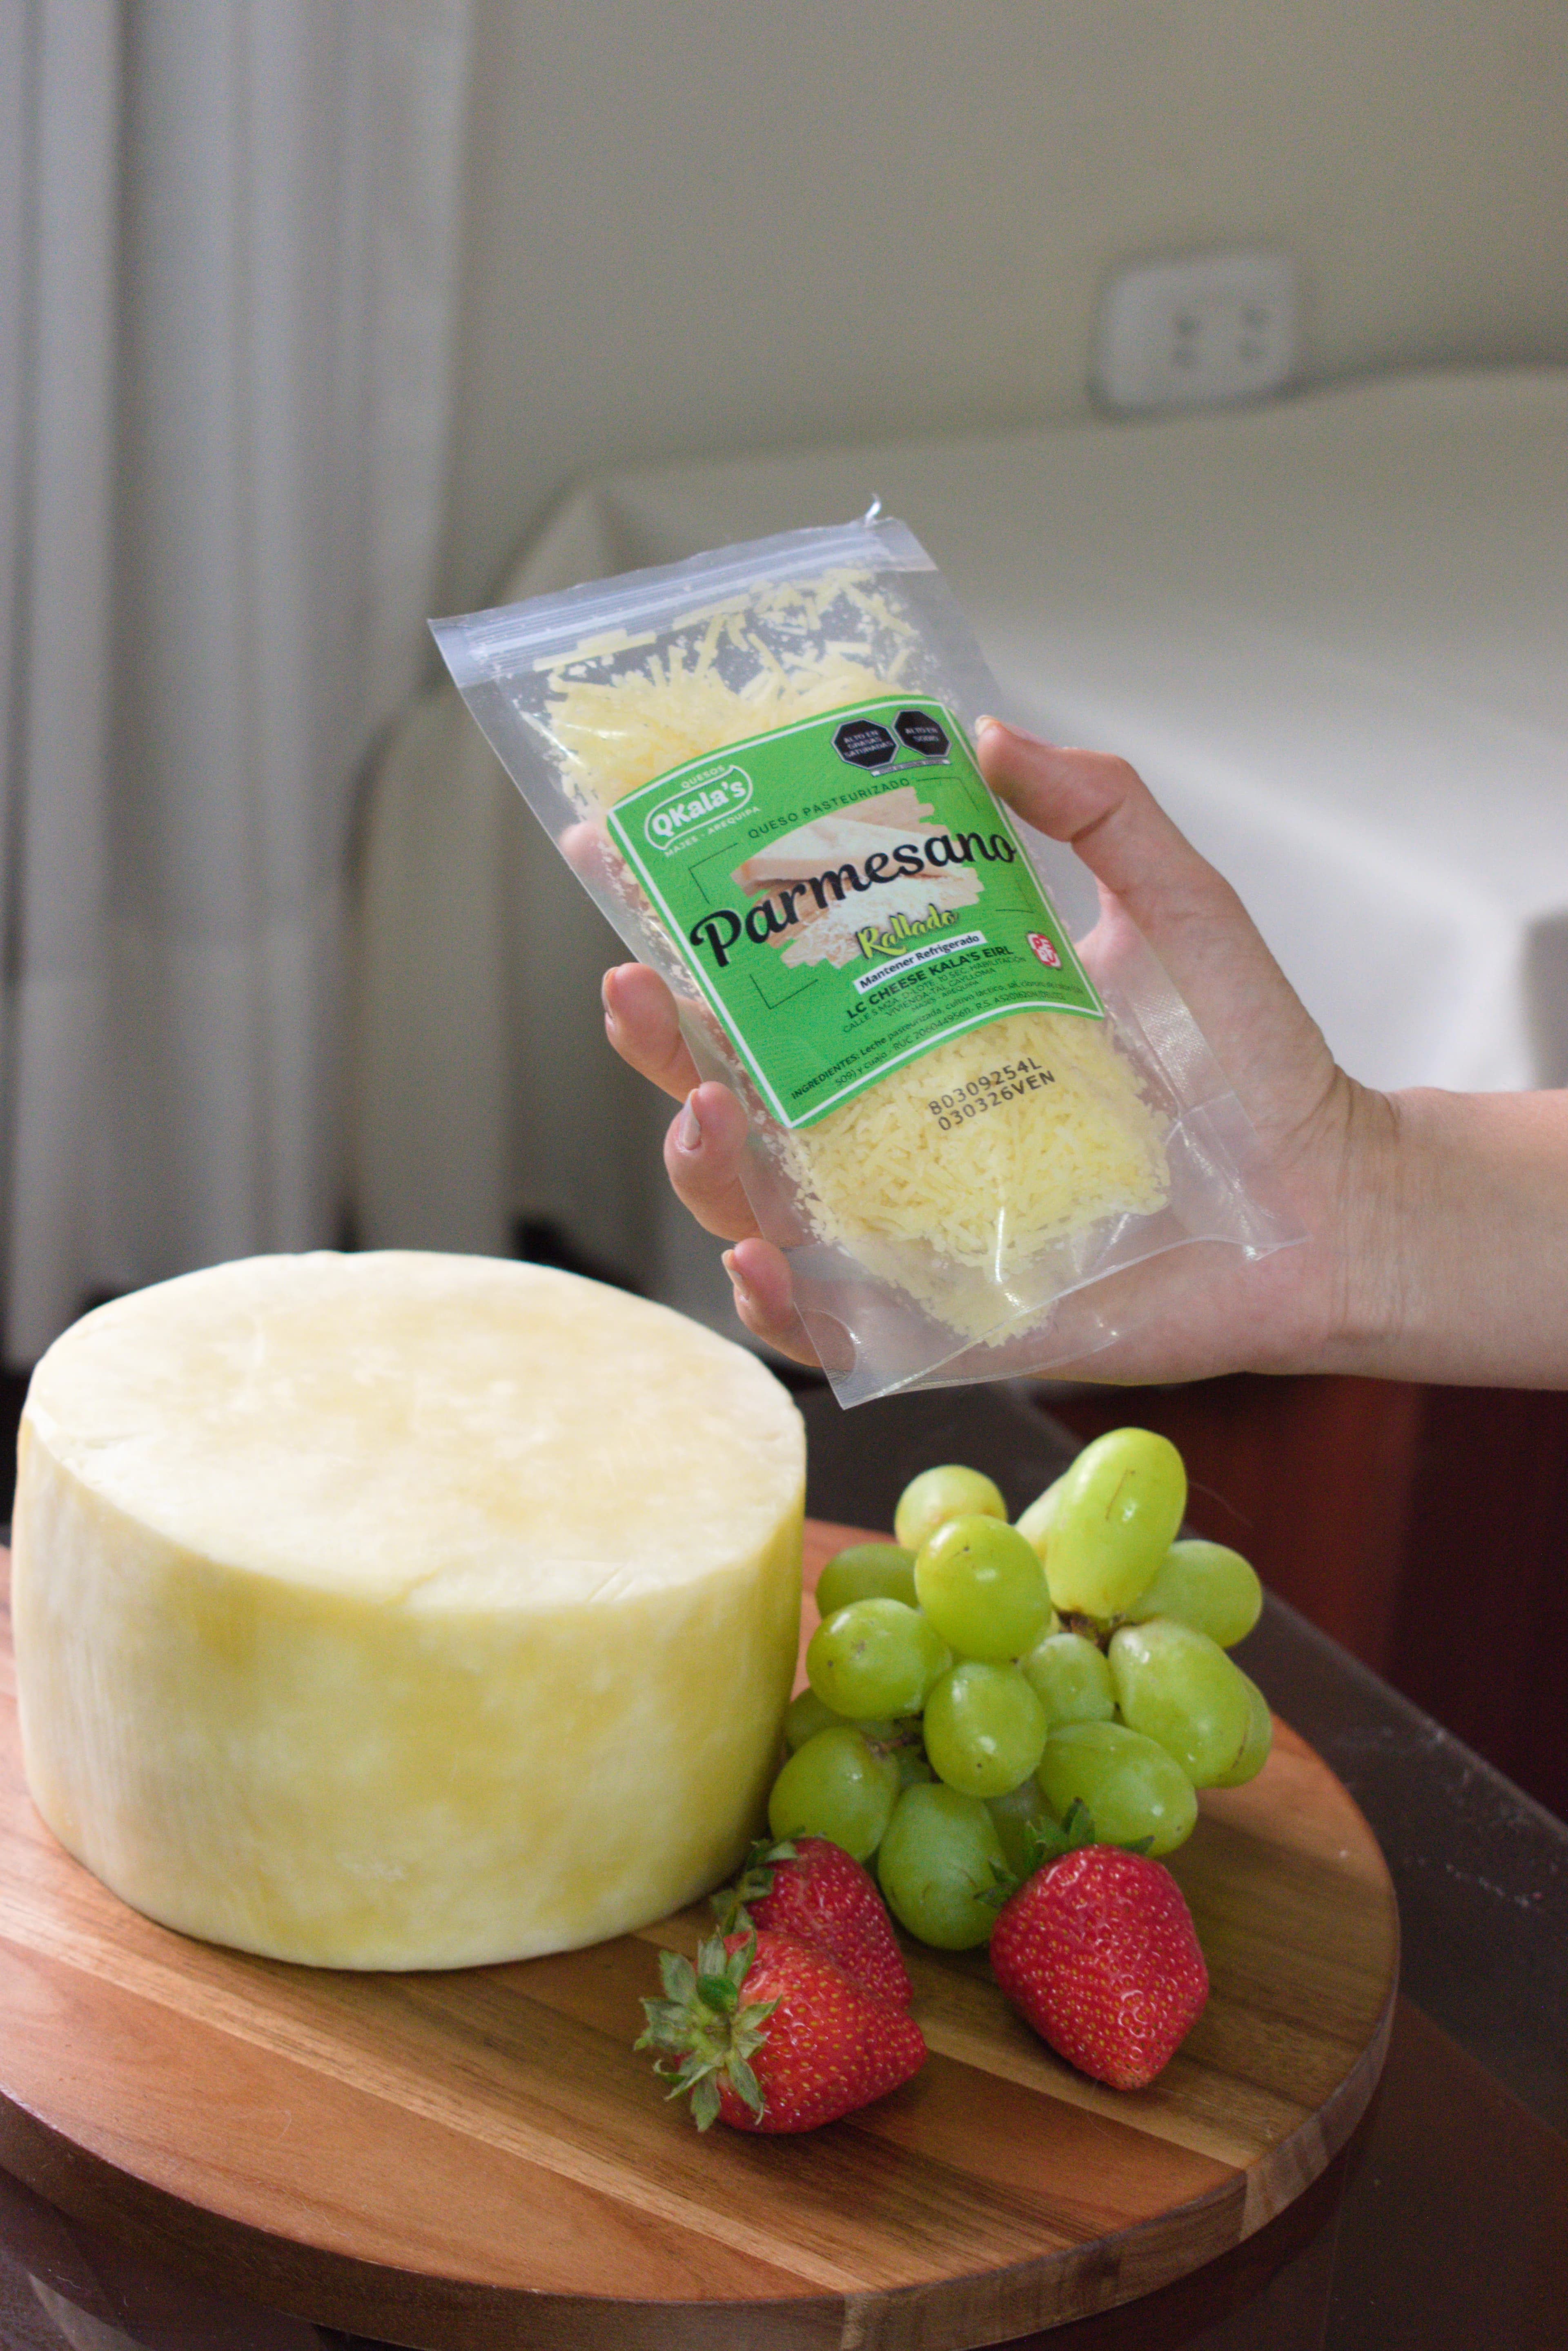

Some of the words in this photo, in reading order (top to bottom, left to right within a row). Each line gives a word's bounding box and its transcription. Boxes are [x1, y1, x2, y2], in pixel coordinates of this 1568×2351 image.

[681, 765, 725, 789] QUESOS
[652, 781, 746, 837] QKala's
[664, 836, 698, 857] MAJES
[708, 806, 761, 834] AREQUIPA
[748, 813, 798, 839] QUESO
[802, 778, 909, 816] PASTEURIZADO
[690, 832, 1017, 968] Parmesano
[855, 903, 958, 959] Rallado
[846, 1002, 866, 1019] LC
[869, 970, 927, 1005] CHEESE
[928, 952, 981, 976] KALA'S
[982, 946, 1014, 958] EIRL
[859, 957, 914, 988] Mantener
[915, 934, 980, 962] Refrigerado
[843, 1012, 871, 1033] CALLE
[791, 1054, 860, 1100] INGREDIENTES:
[859, 1038, 886, 1055] Leche
[857, 1066, 862, 1075] y
[864, 1052, 887, 1069] cuajo
[893, 1035, 913, 1050] RUC
[929, 1057, 1042, 1115] 80309254L
[938, 1070, 1055, 1131] 030326VEN
